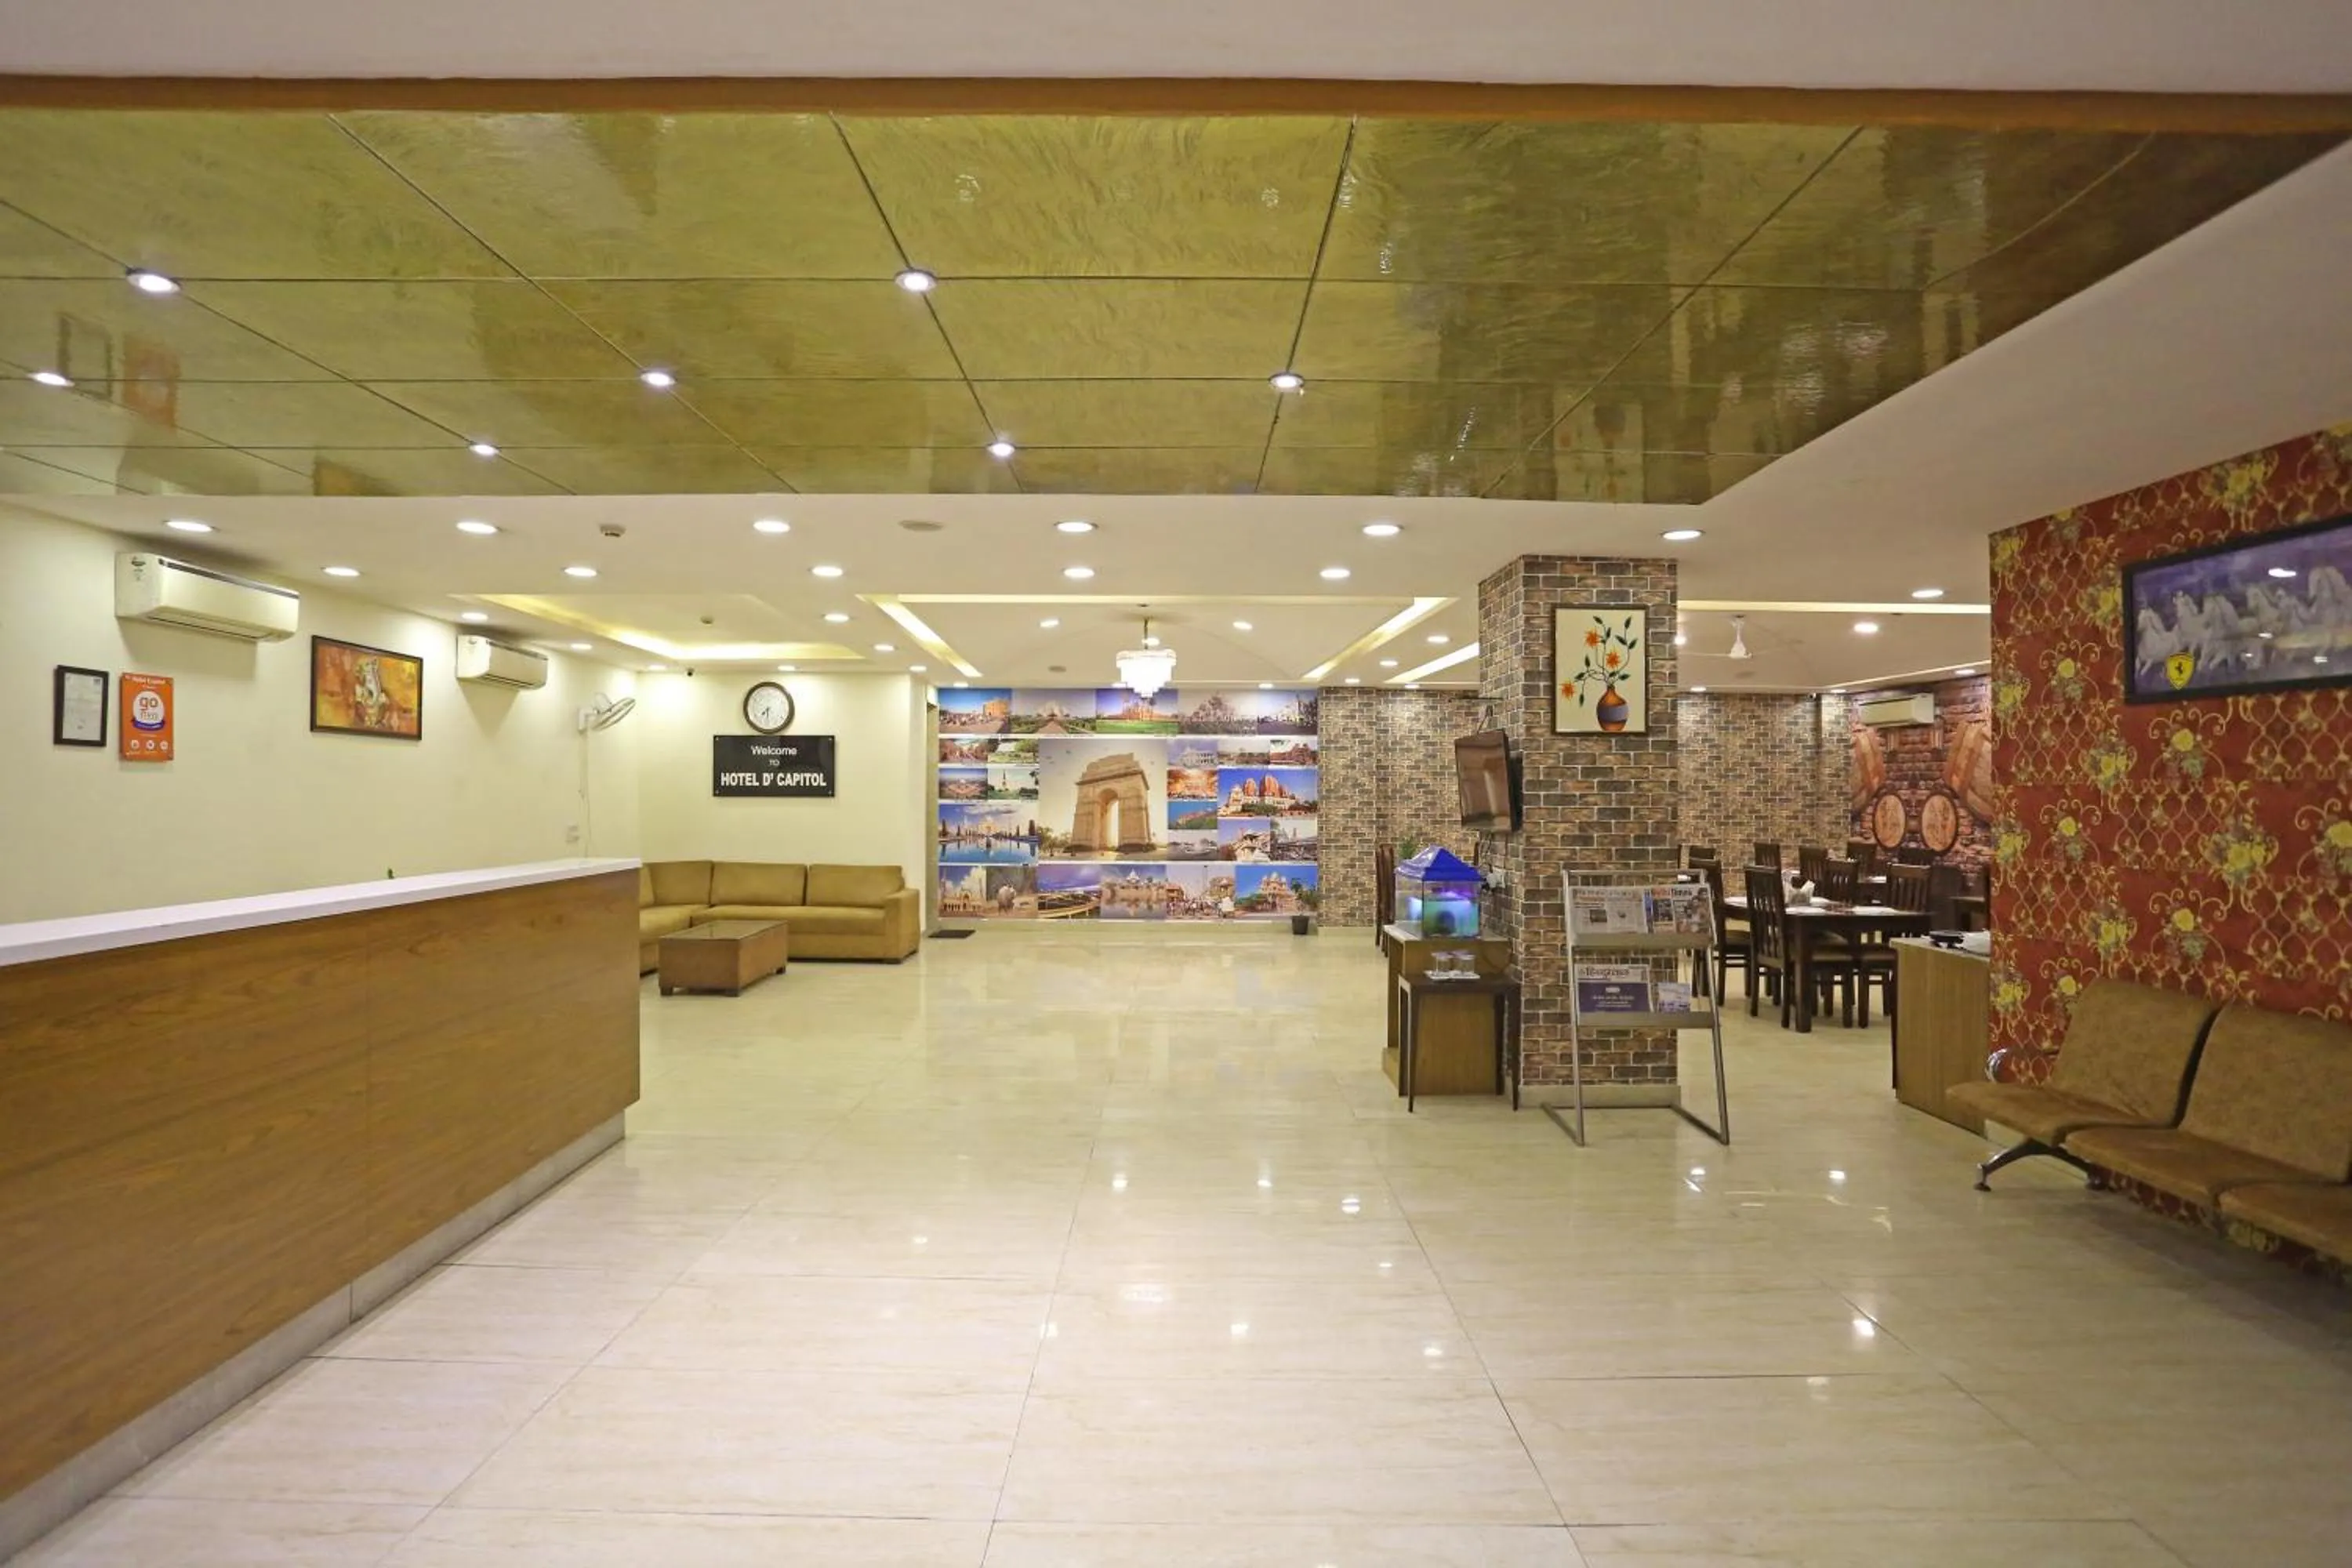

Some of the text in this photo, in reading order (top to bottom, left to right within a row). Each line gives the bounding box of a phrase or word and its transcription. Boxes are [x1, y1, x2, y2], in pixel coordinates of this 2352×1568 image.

[750, 745, 797, 755] Welcome
[720, 772, 827, 786] HOTEL D' CAPITOL
